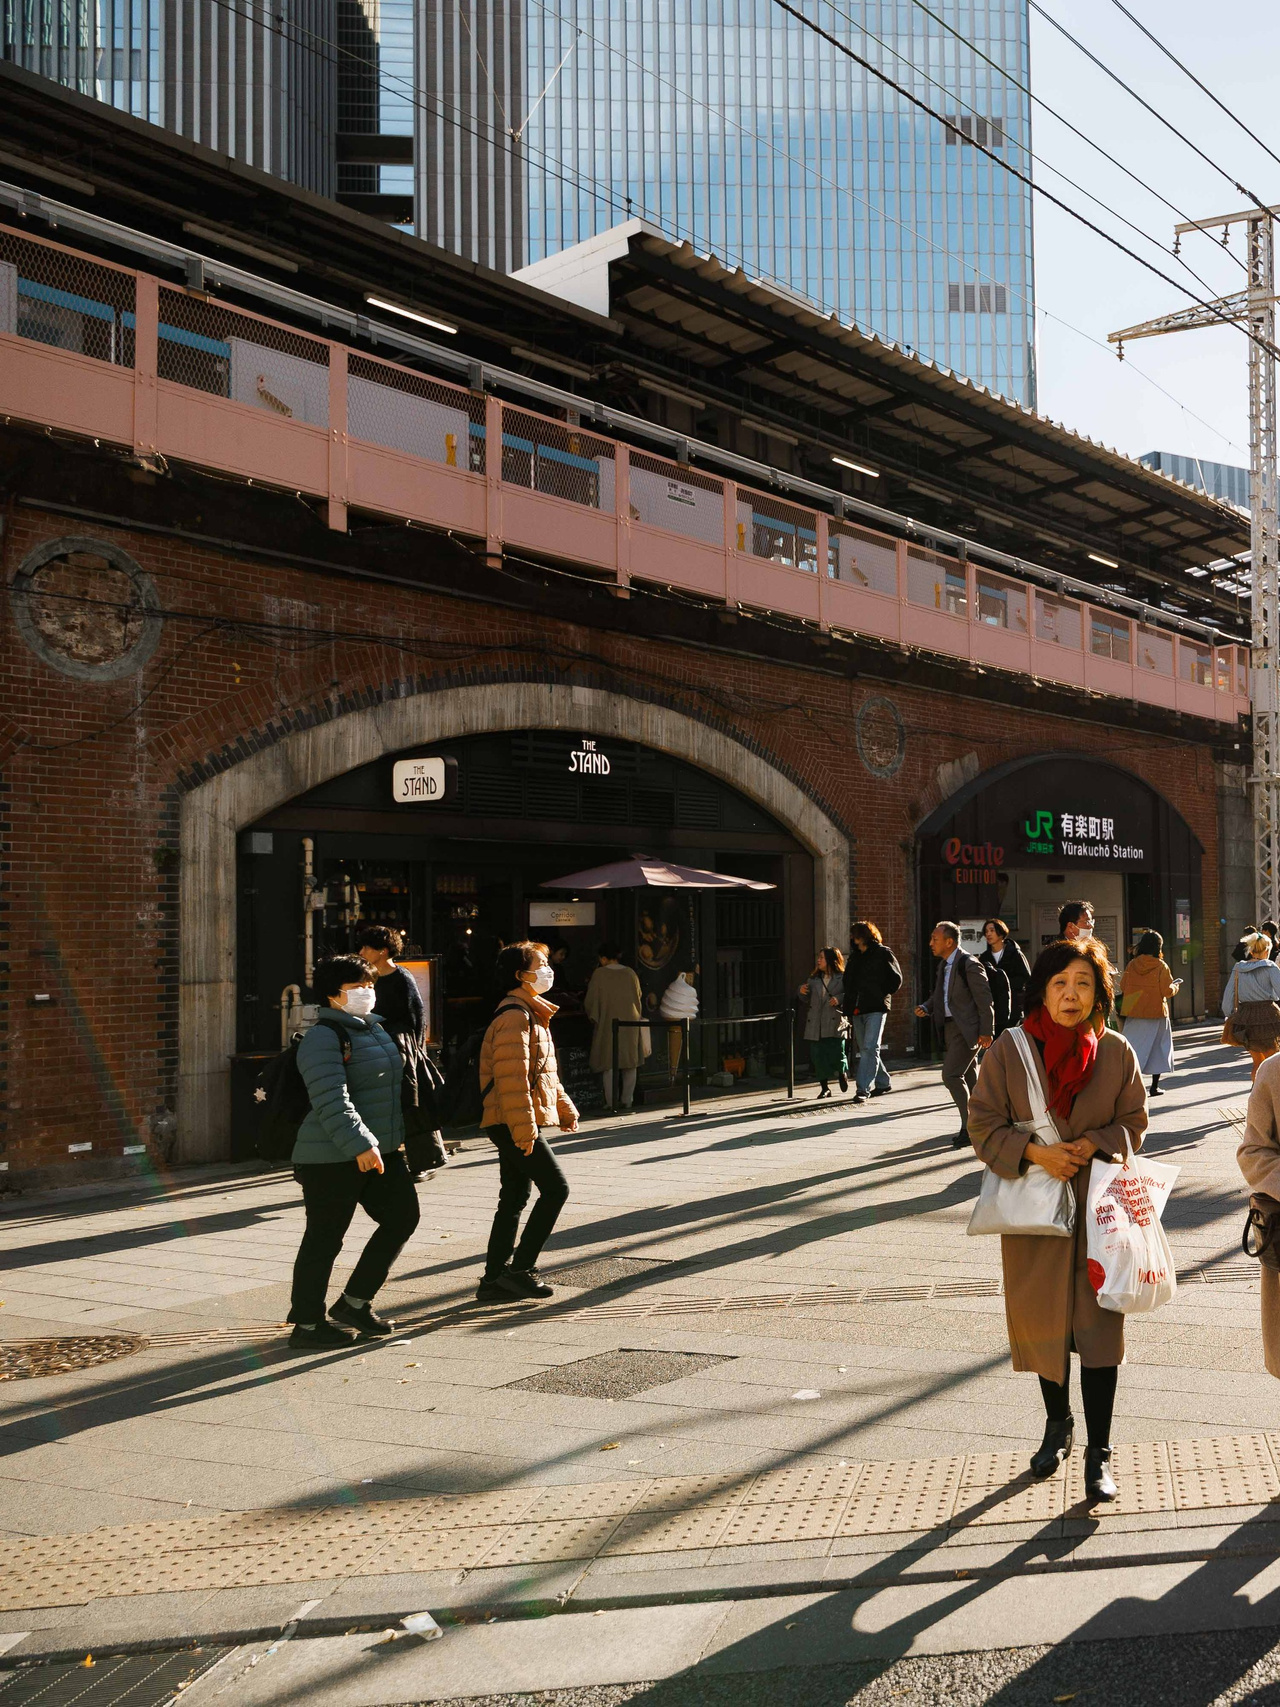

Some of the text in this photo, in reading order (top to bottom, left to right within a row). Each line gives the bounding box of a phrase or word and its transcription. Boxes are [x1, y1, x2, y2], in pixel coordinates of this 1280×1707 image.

[582, 739, 597, 751] THE
[413, 765, 425, 775] THE
[568, 751, 611, 775] STAND
[402, 776, 437, 797] STAND
[1025, 810, 1054, 840] JR
[1060, 813, 1114, 841] 有楽町駅
[945, 837, 1005, 867] ecute
[1113, 843, 1144, 860] Station
[956, 868, 997, 885] EDITION
